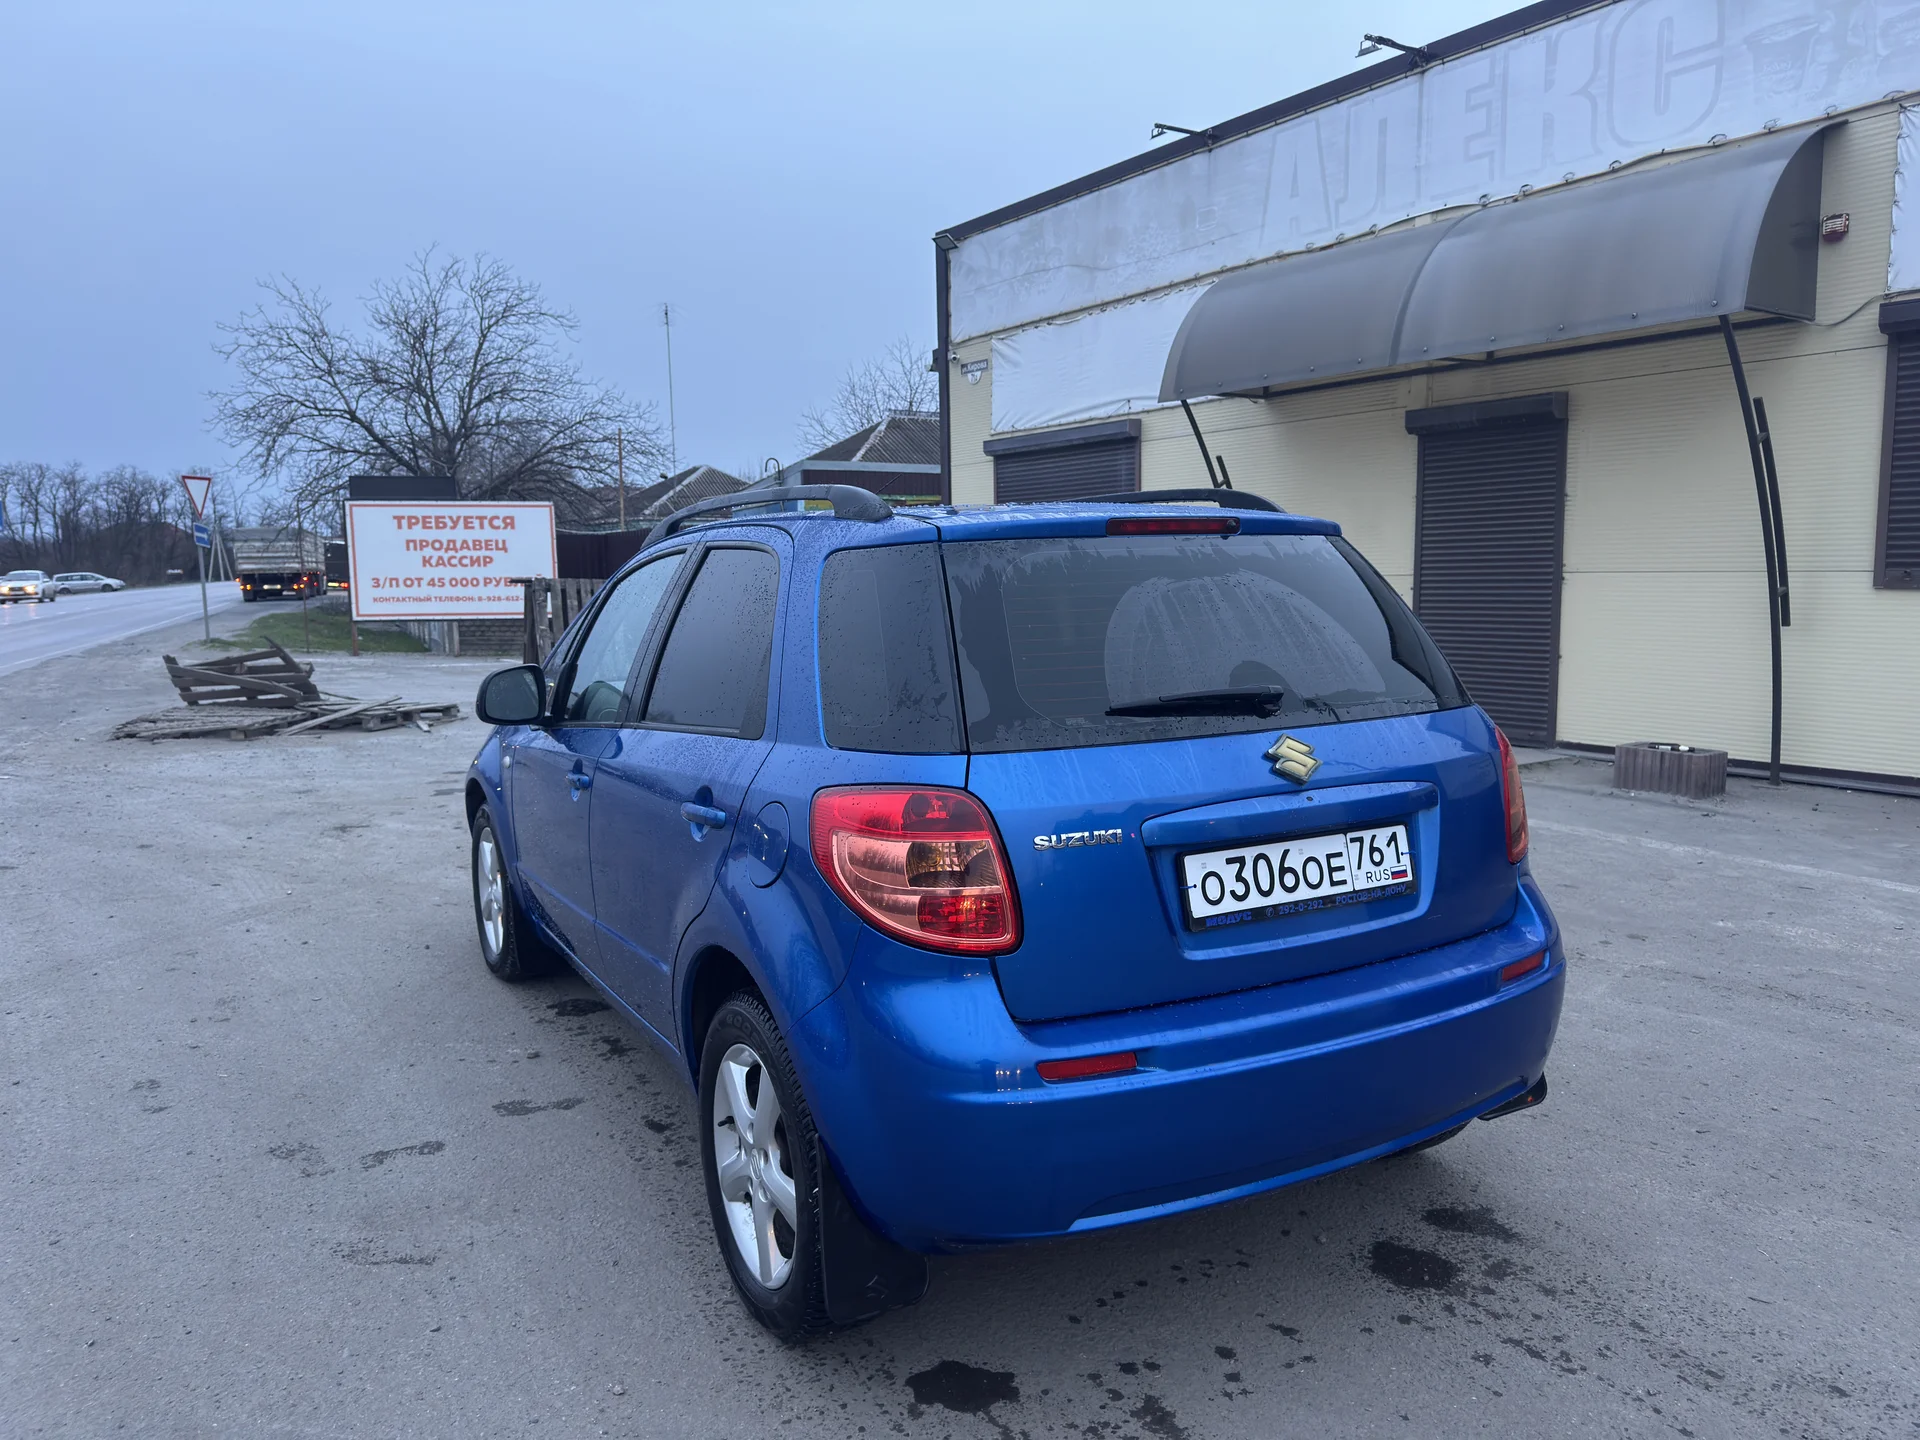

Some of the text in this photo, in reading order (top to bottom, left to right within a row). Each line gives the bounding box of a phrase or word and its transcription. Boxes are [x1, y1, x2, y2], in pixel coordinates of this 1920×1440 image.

[392, 515, 515, 531] ТРЕБУЕТСЯ
[405, 539, 508, 553] ПРОДАВЕЦ
[422, 555, 494, 568] КАССИР
[403, 577, 423, 588] ОТ
[427, 577, 446, 588] 45
[449, 577, 480, 588] 000
[373, 595, 432, 604] КОНТАКТНЫЙ
[1033, 828, 1123, 851] SUZUKI
[1201, 831, 1401, 906] О306ОЕ 761
[1366, 871, 1391, 884] RUS
[1205, 884, 1407, 927] МОДУС 292-0-292 РОСТОВ-НА-ДОНУ
